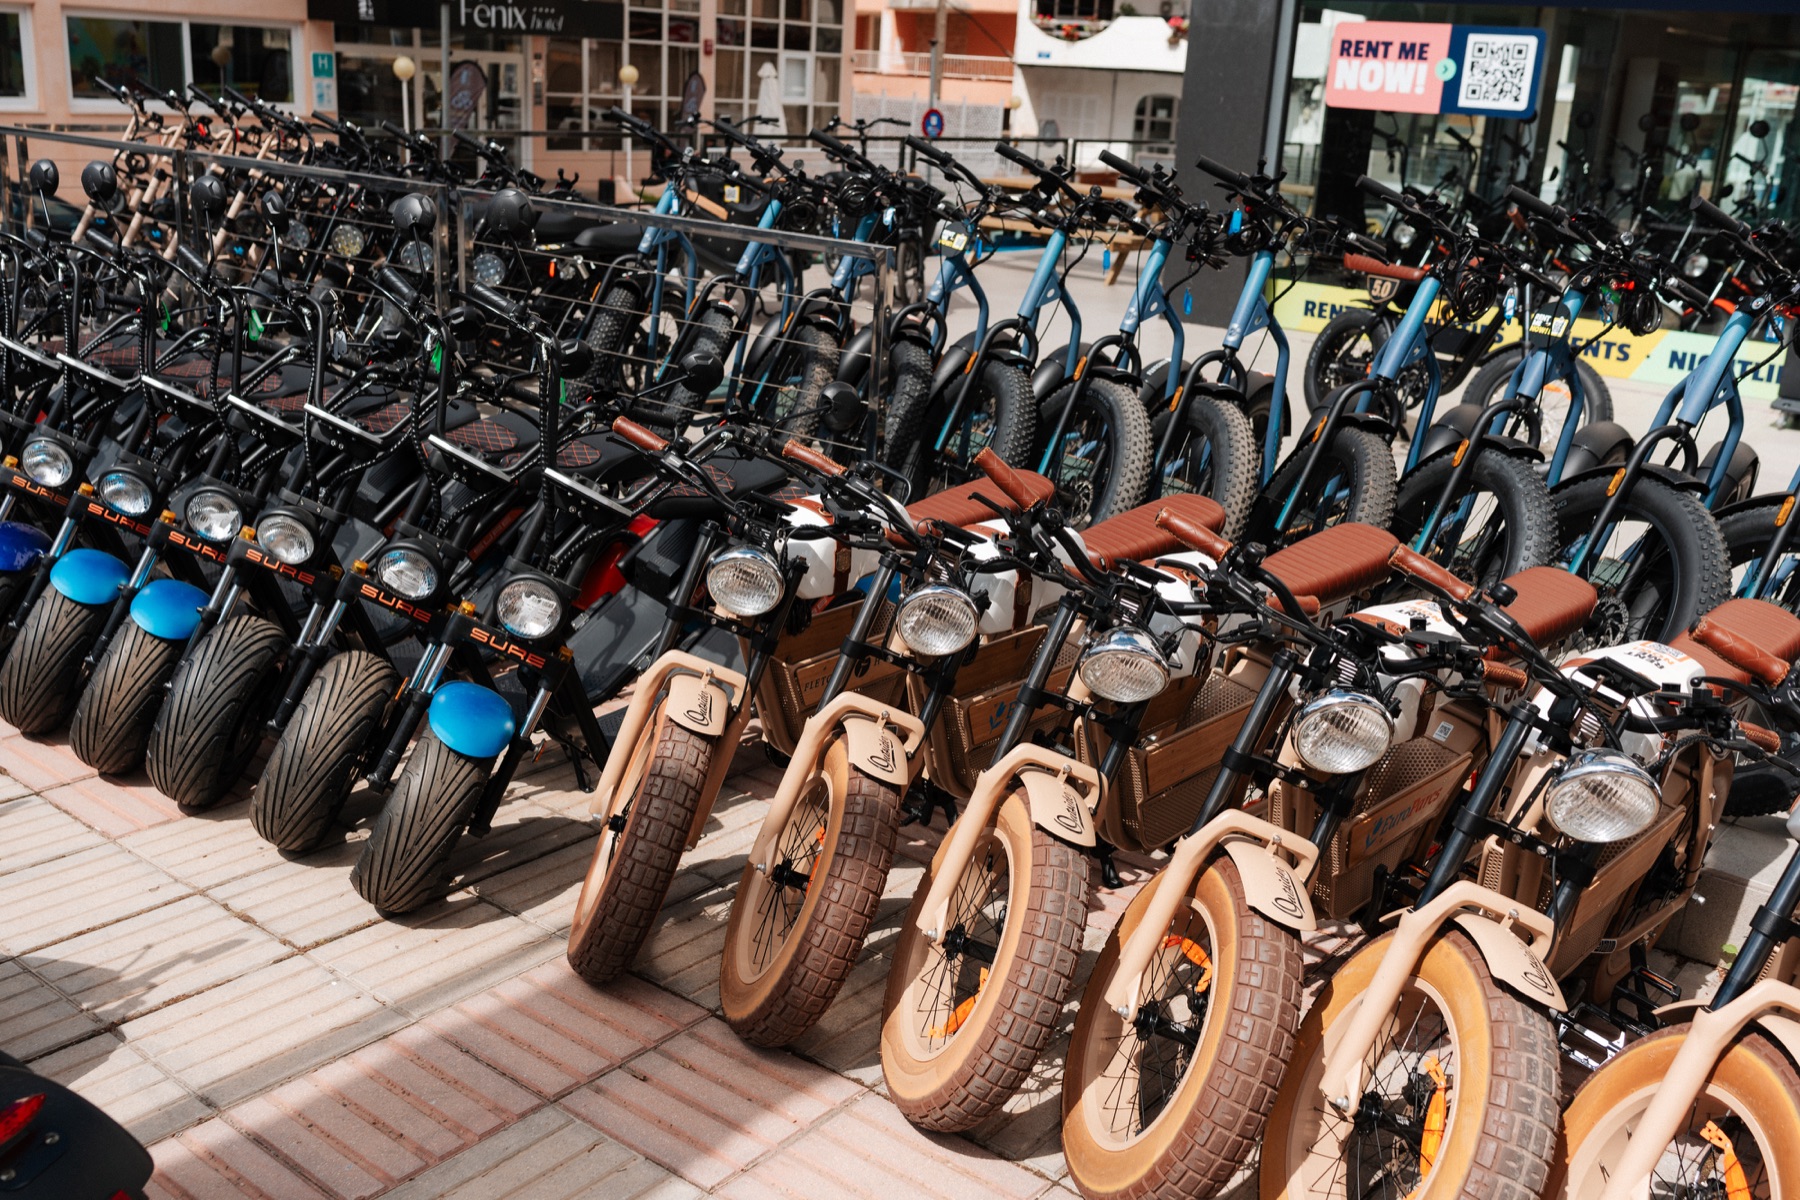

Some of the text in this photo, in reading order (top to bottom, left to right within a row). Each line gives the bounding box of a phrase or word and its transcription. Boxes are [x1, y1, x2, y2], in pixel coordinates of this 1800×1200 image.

[318, 55, 328, 69] H
[1339, 39, 1430, 61] RENT ME
[1333, 59, 1429, 95] NOW!
[1303, 300, 1352, 320] REN
[11, 475, 69, 507] SURE
[87, 502, 152, 536] SURE
[168, 530, 227, 563] SURE
[245, 548, 316, 585] SURE
[360, 583, 432, 624] SURE
[470, 627, 546, 669] SURE
[1624, 651, 1665, 670] RENT
